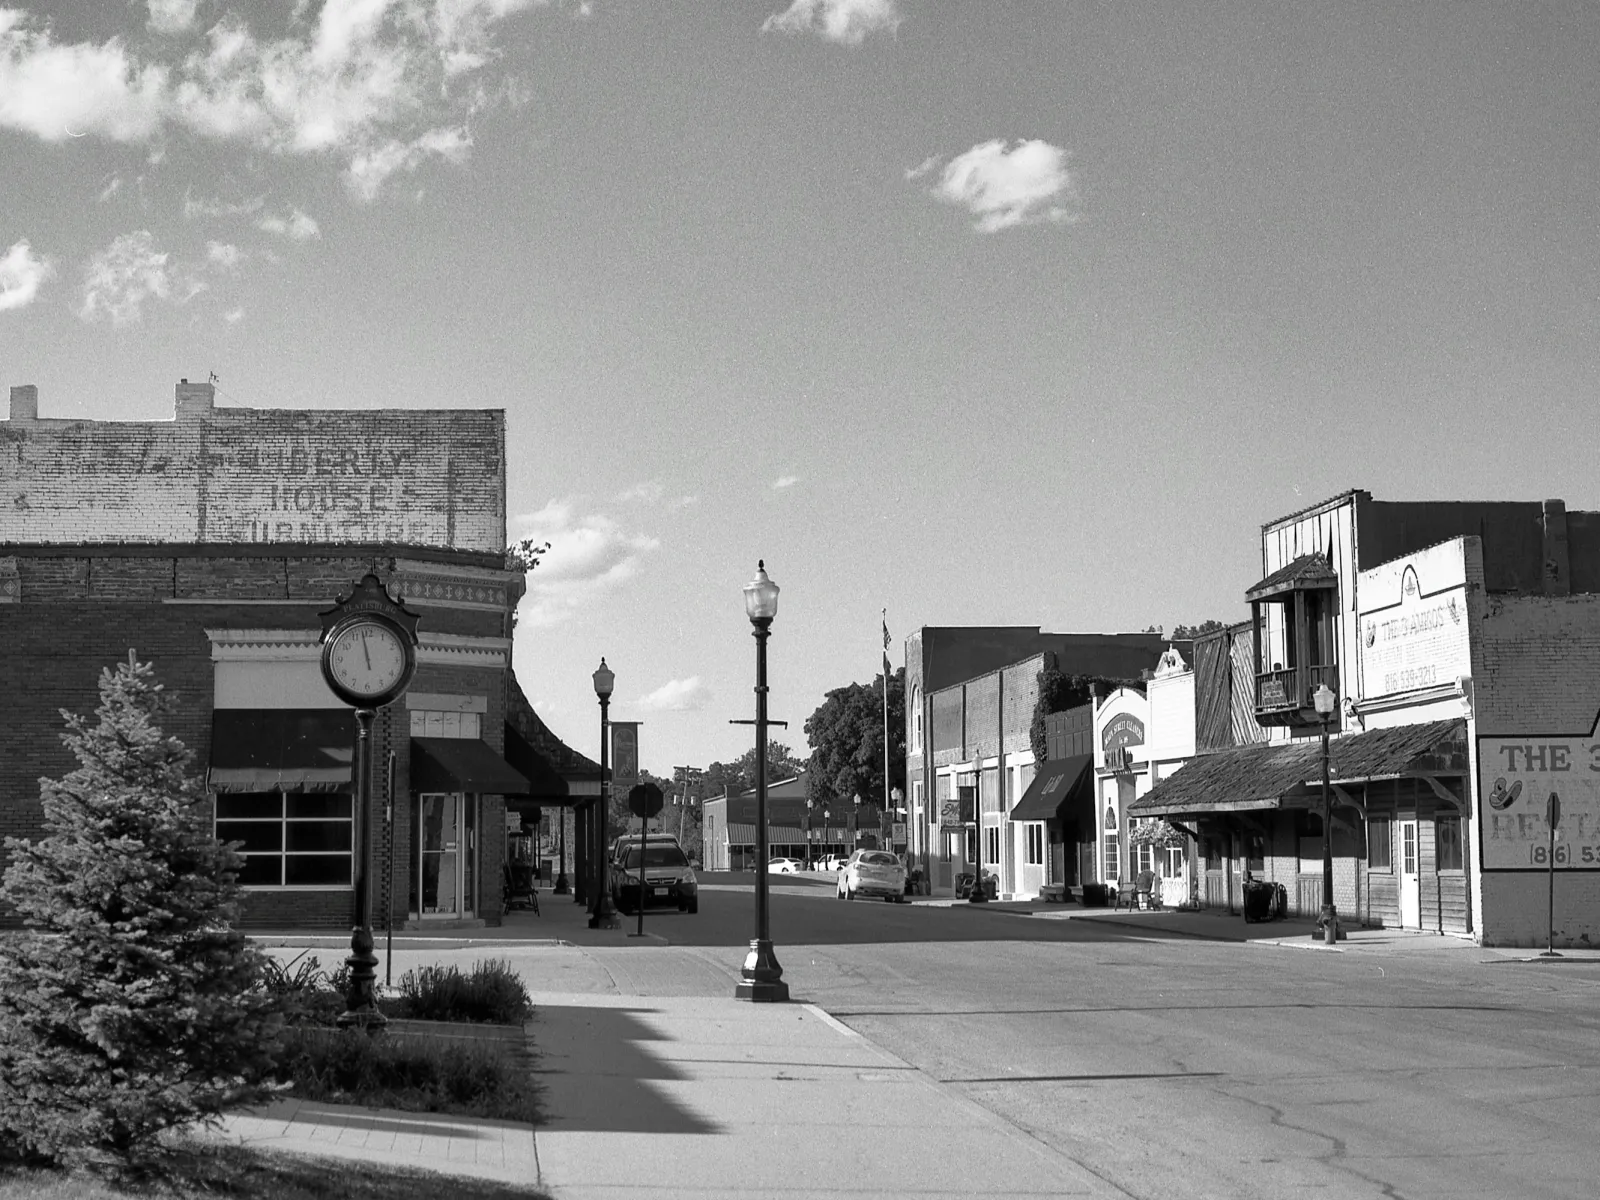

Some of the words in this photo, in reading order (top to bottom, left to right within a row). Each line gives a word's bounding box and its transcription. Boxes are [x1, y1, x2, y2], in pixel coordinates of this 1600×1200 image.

[252, 447, 412, 476] LIBERTY
[270, 484, 390, 512] HOUSE
[1499, 745, 1571, 772] THE
